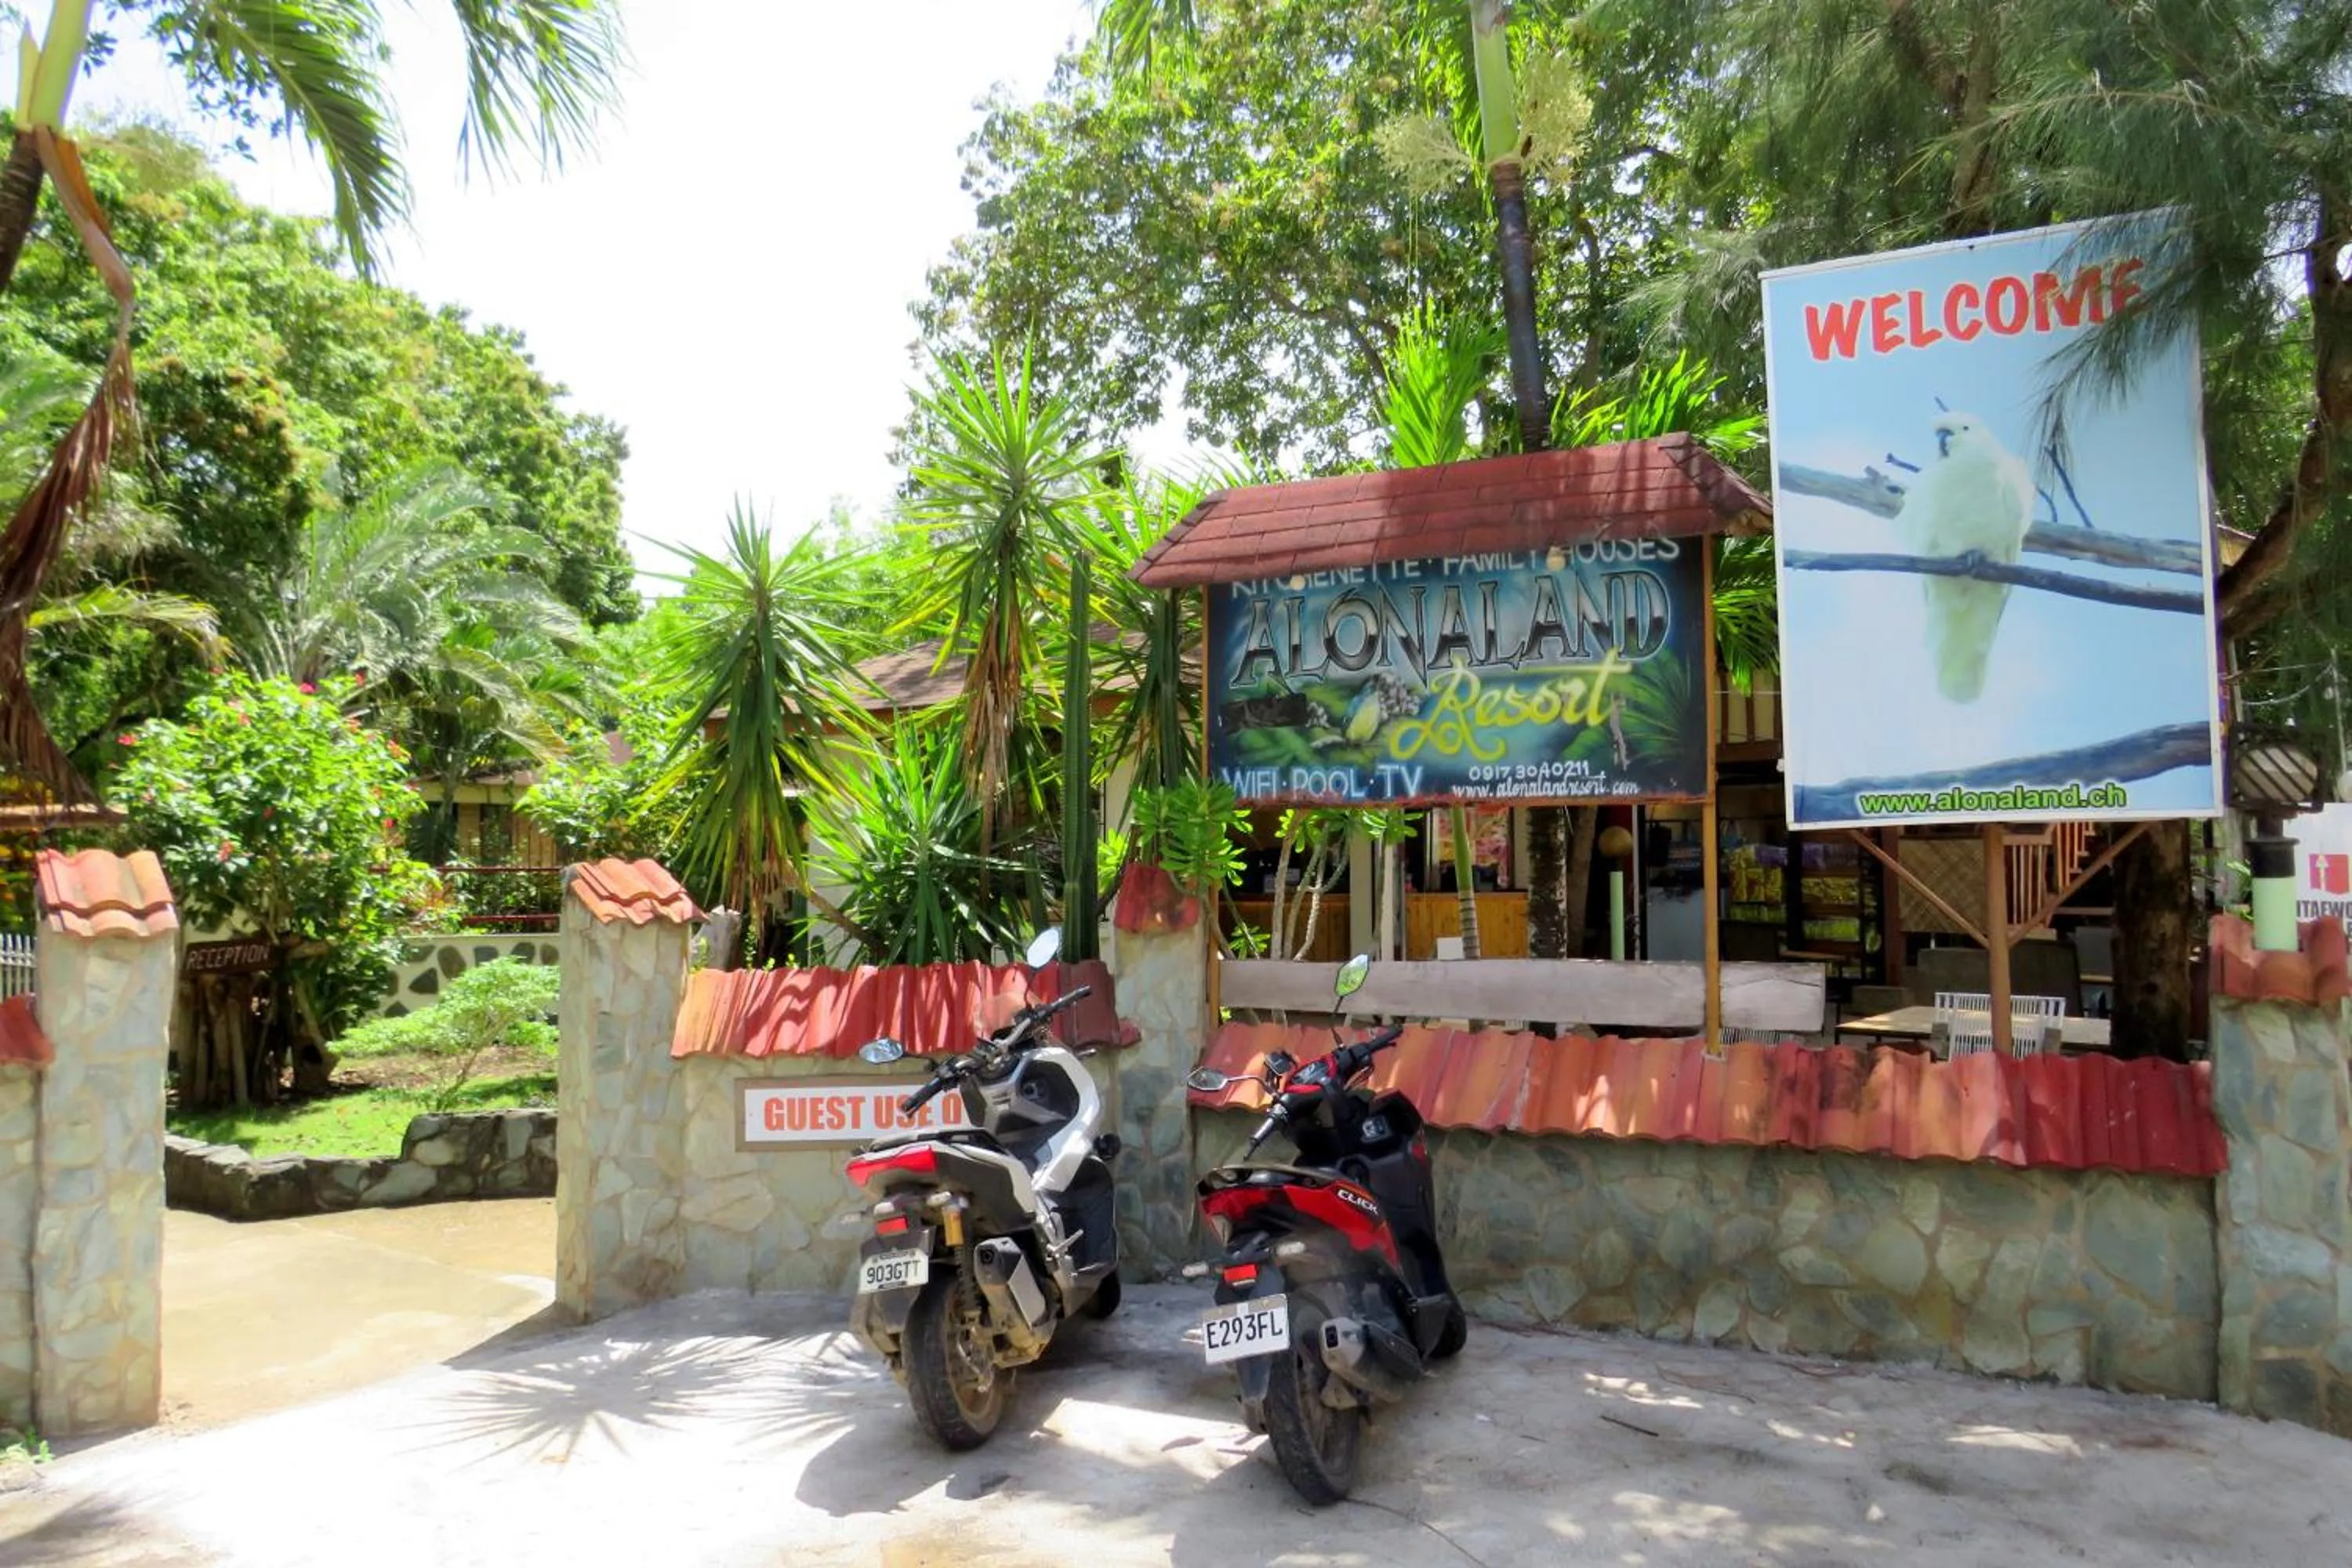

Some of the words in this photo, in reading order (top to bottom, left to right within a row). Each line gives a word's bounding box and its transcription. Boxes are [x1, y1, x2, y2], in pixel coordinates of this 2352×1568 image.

[1805, 256, 2144, 361] WELCOME
[1229, 569, 1671, 693] ALONALAND
[1388, 648, 1632, 763] Resort
[1221, 765, 1278, 800] WIFI
[1292, 765, 1367, 800] POOL
[1377, 763, 1424, 798] TV
[1858, 782, 2127, 814] www.alonaland.ch
[186, 944, 270, 970] RECEPTION
[764, 1095, 866, 1131] GUEST
[1337, 1189, 1379, 1216] CLICK
[866, 1259, 922, 1284] 903GTT
[1206, 1311, 1283, 1349] E293FL
